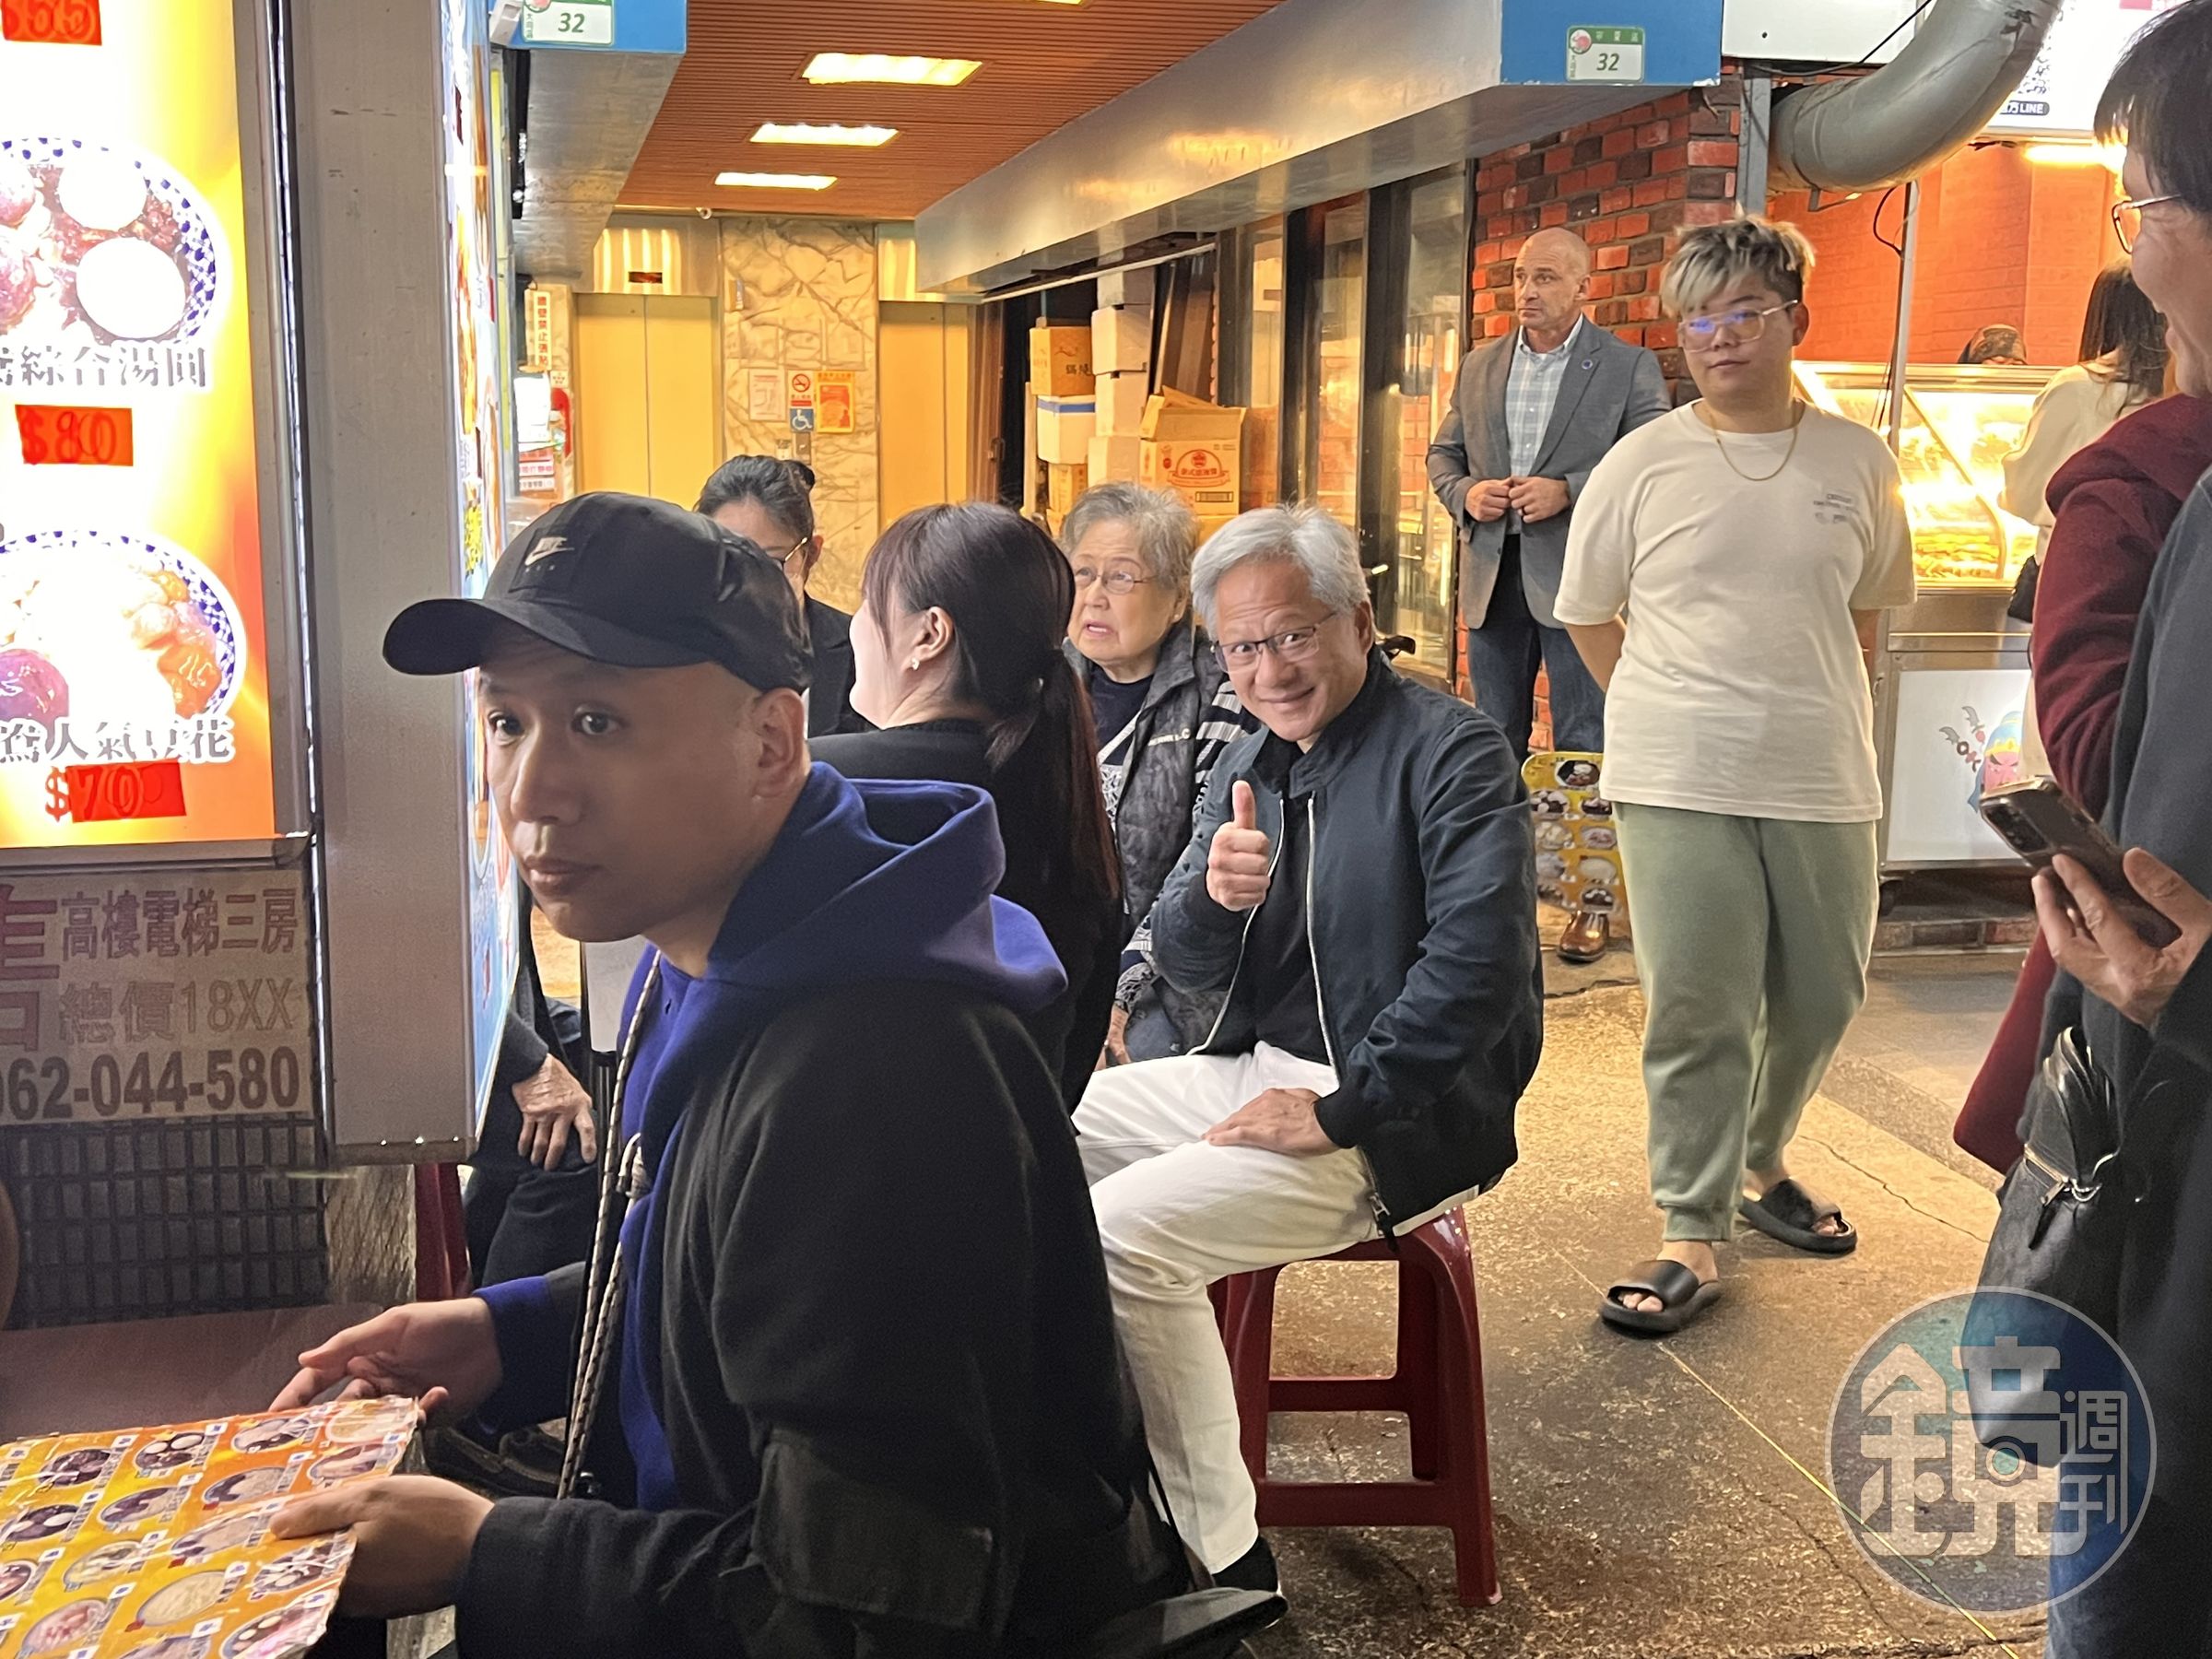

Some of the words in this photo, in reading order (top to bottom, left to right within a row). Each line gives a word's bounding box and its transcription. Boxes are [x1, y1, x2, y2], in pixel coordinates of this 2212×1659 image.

[558, 12, 585, 33] 32
[1596, 53, 1620, 71] 32
[61, 888, 298, 962] 高樓電梯三房
[0, 1045, 300, 1121] 62-044-580
